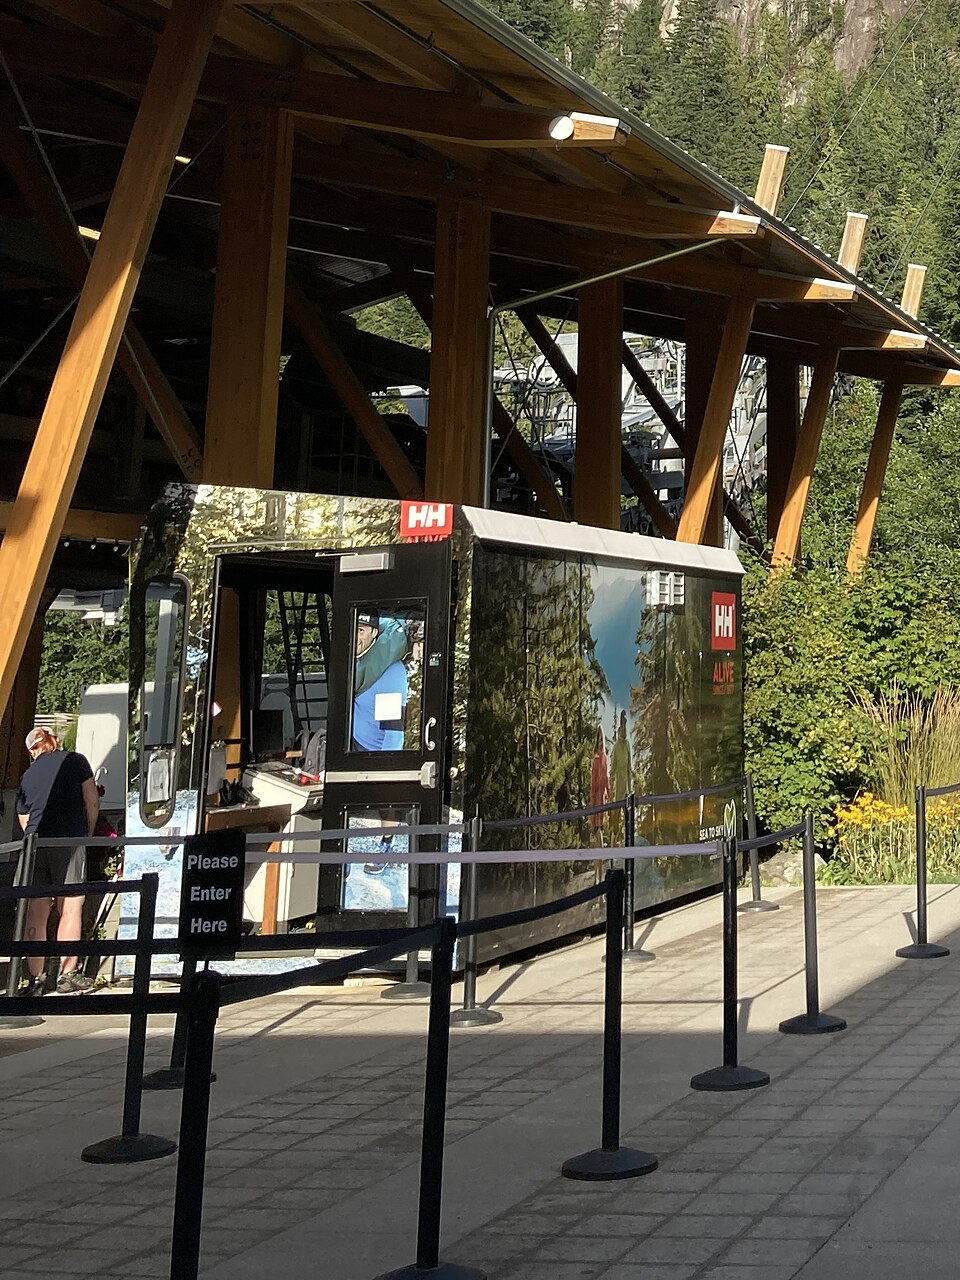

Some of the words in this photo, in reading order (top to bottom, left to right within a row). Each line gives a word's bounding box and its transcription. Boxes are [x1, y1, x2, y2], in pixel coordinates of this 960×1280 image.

[408, 504, 446, 529] HH
[715, 605, 733, 638] HH
[713, 661, 735, 683] ALIVE
[187, 854, 239, 870] Please
[190, 886, 232, 901] Enter
[190, 917, 228, 933] Here
